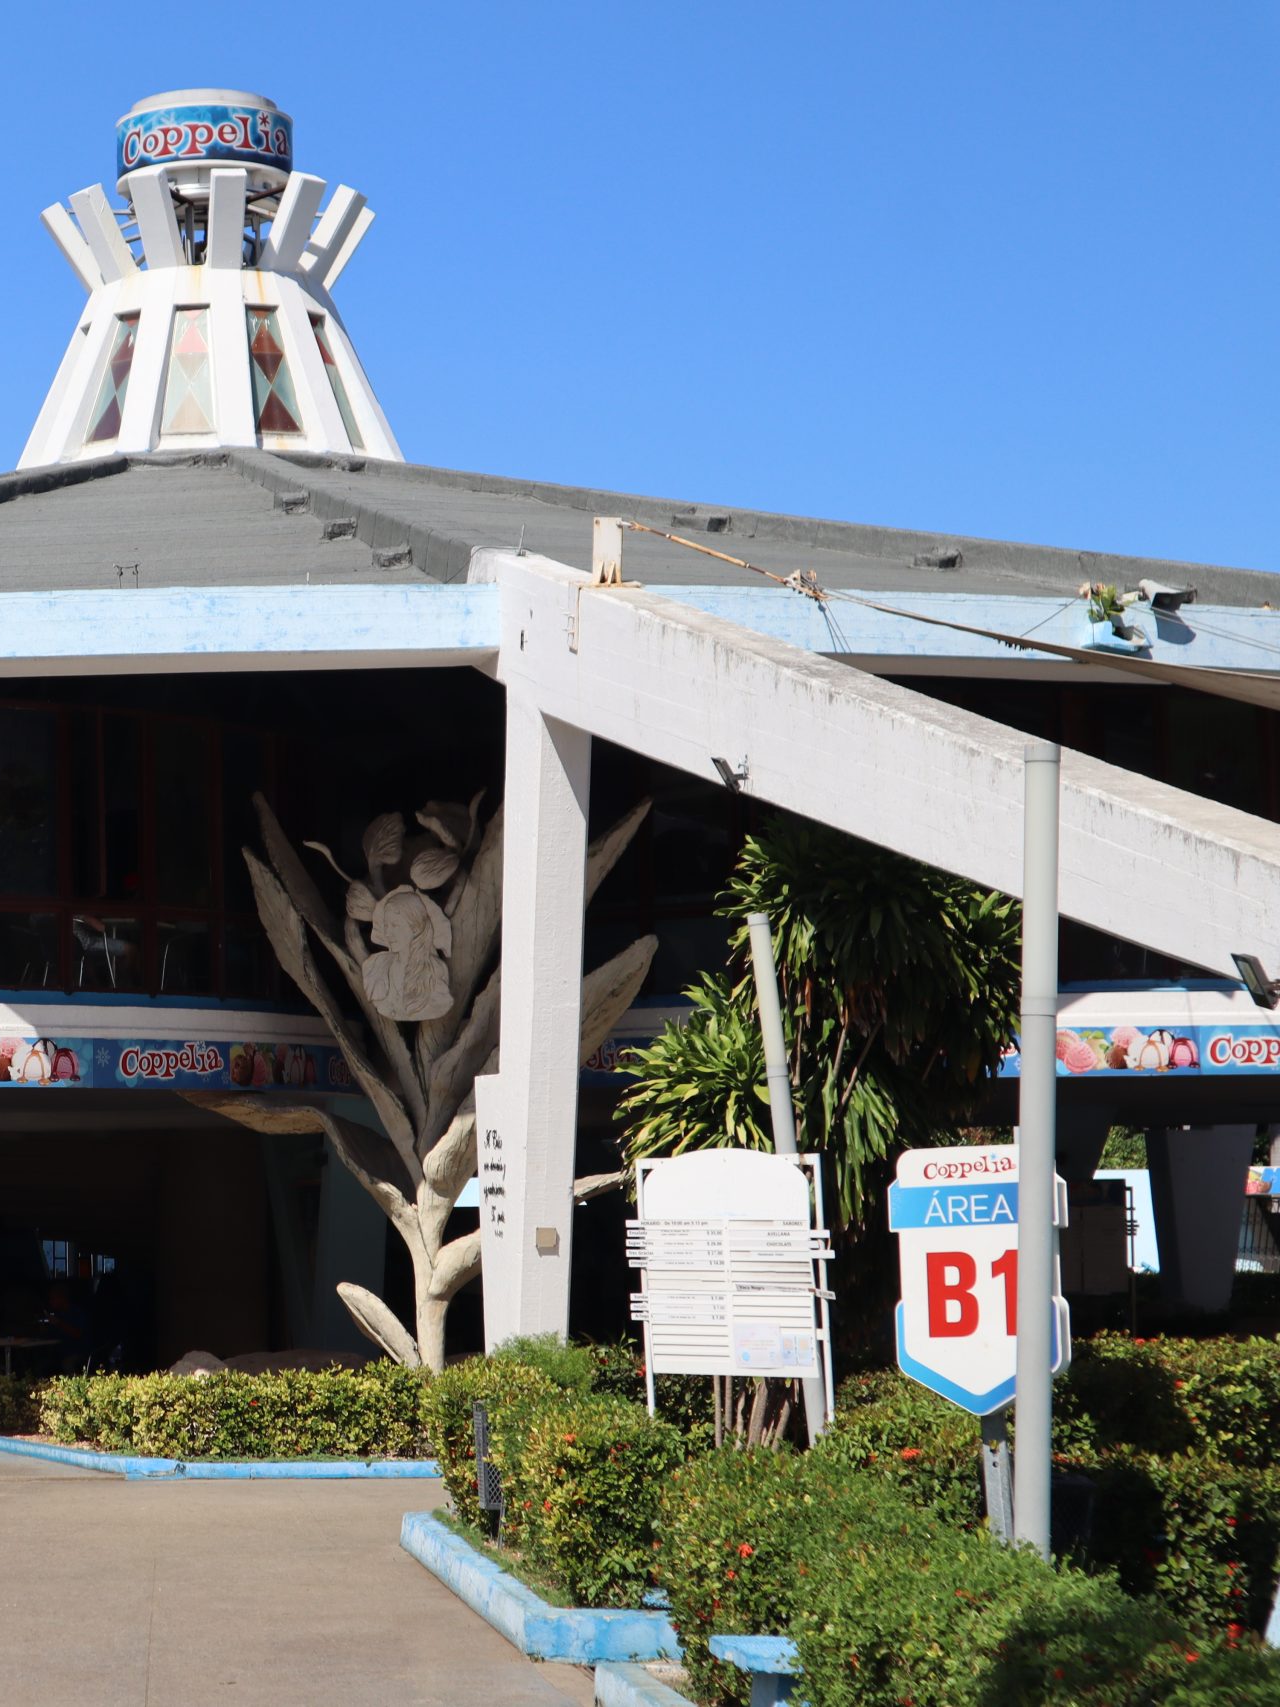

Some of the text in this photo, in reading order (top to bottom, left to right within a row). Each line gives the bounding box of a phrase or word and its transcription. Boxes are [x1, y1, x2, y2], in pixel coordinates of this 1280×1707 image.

[124, 112, 289, 165] Coppelia
[121, 1044, 220, 1077] Coppelia
[923, 1154, 1014, 1180] Coppelia
[924, 1190, 1015, 1225] ÁREA
[926, 1249, 1018, 1338] B1
